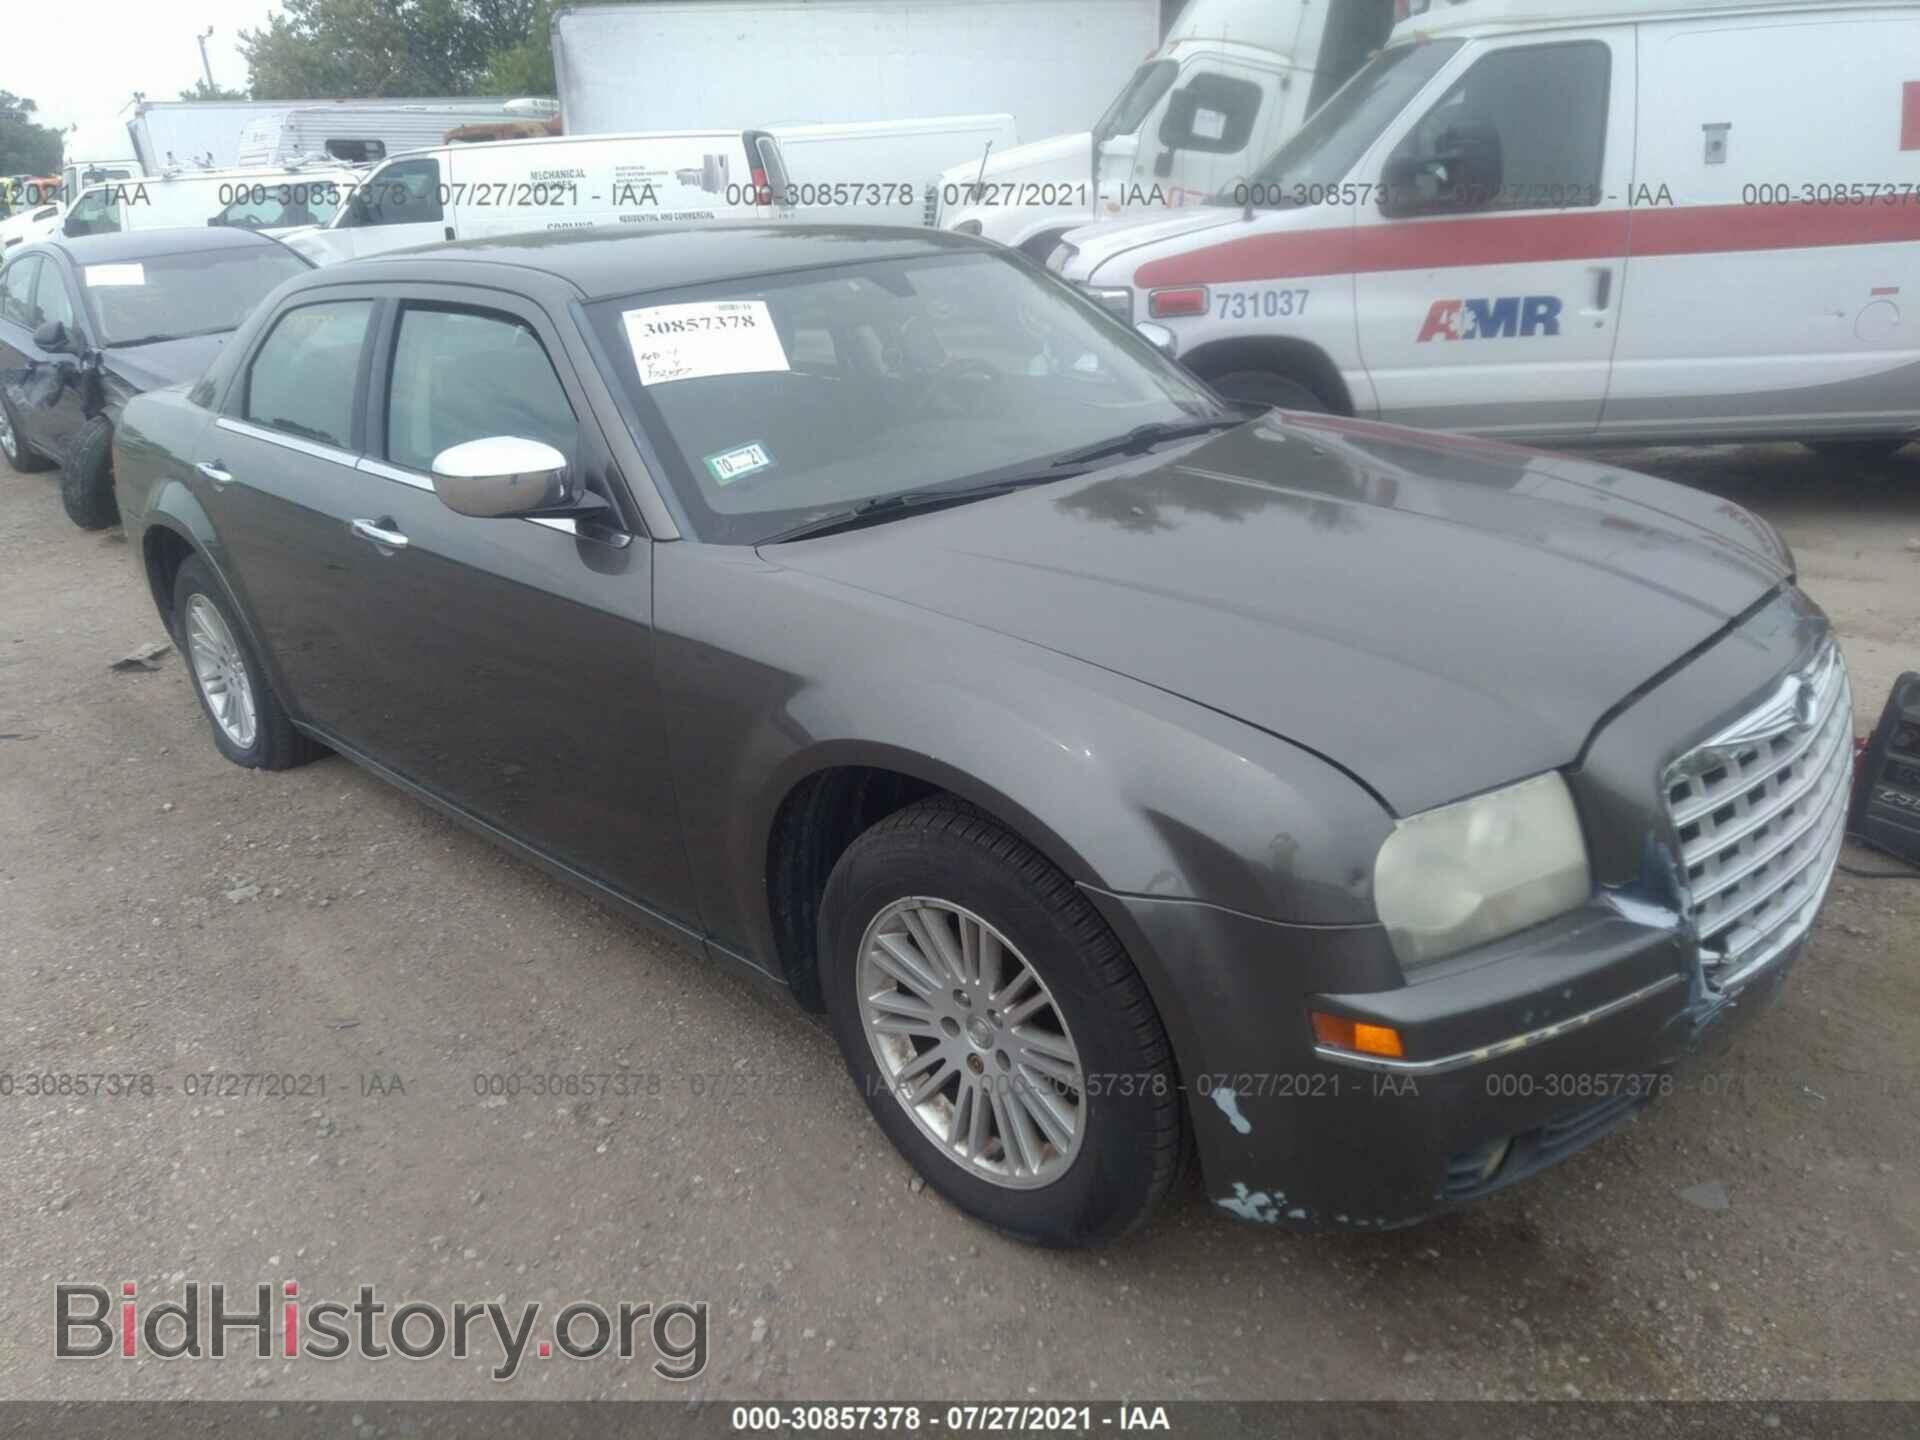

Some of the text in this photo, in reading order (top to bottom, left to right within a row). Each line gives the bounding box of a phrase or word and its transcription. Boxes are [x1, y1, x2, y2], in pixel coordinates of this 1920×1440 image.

[1215, 289, 1310, 319] 731037
[1416, 295, 1563, 343] AMR
[643, 315, 756, 337] 30857378
